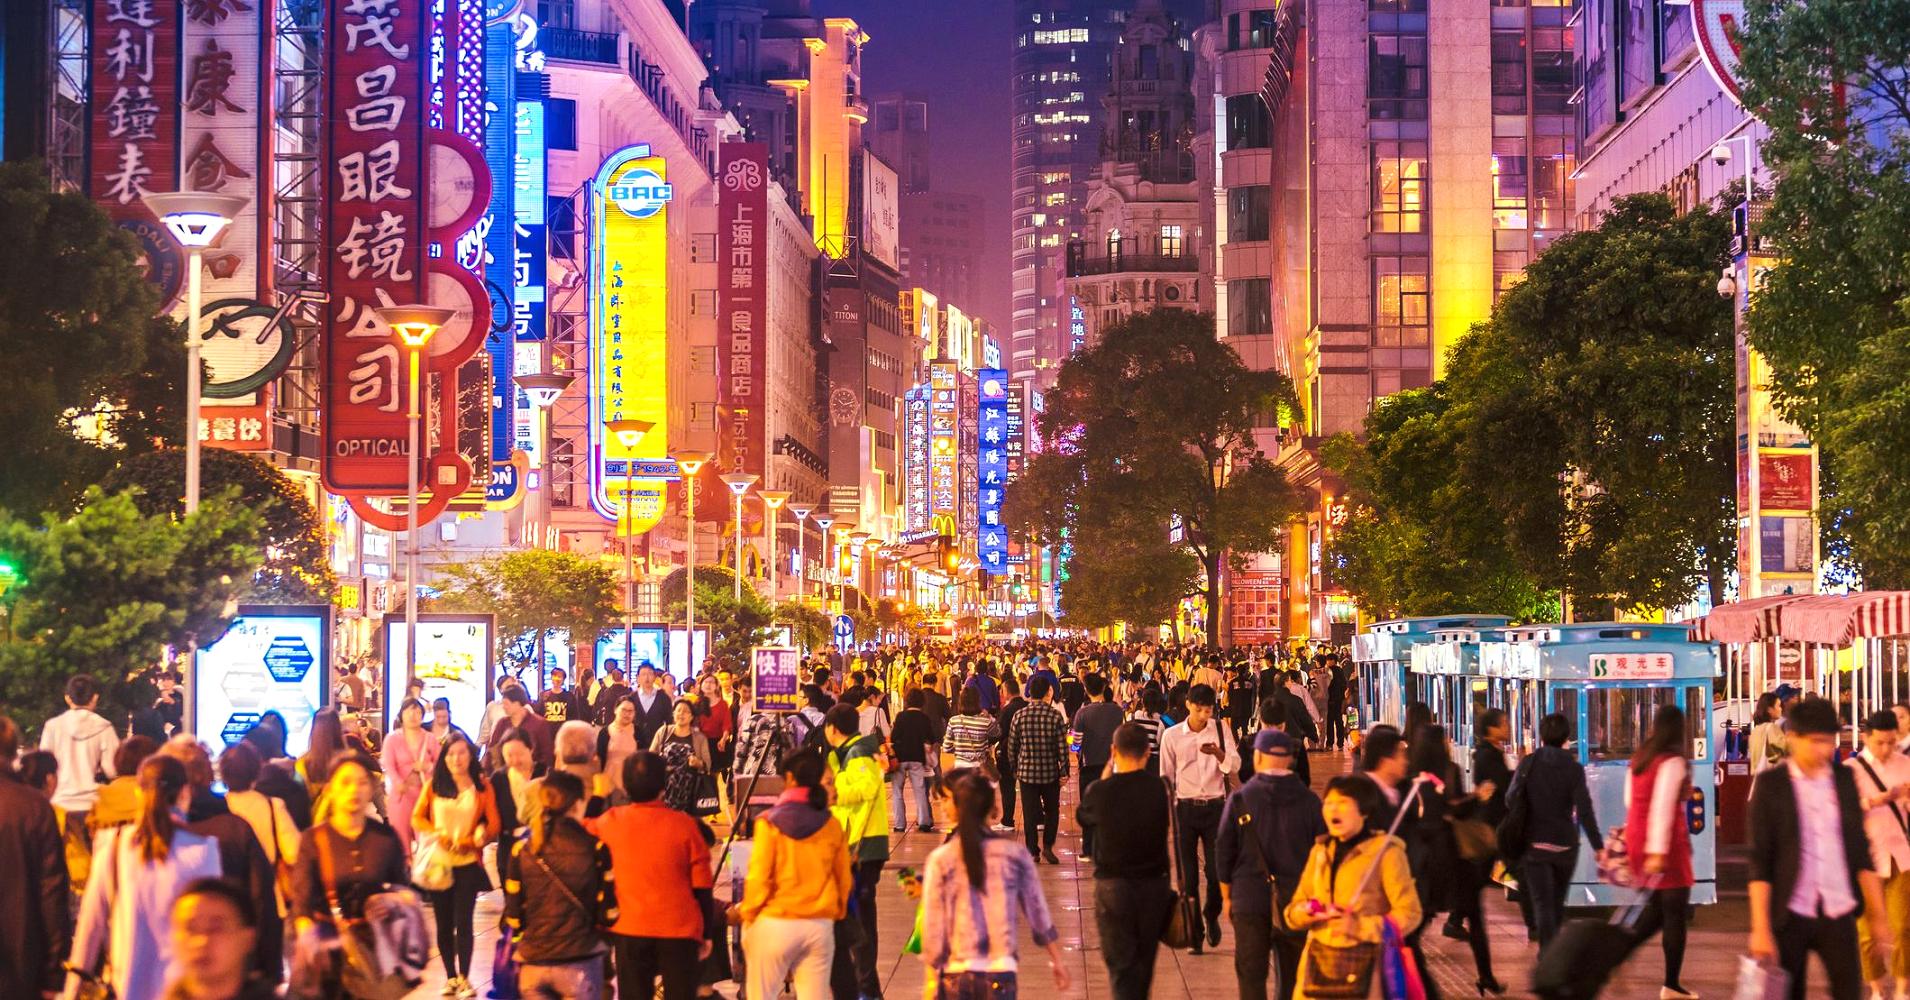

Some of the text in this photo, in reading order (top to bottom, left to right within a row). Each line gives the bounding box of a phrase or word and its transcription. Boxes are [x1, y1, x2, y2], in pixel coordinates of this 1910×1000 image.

[611, 186, 671, 200] BAC
[335, 0, 412, 412] 茂昌眼镜公司
[731, 203, 753, 396] 上海市第一食品商店
[834, 311, 858, 320] TITONI
[756, 651, 797, 676] 快照
[1616, 657, 1667, 669] 观光车
[1697, 741, 1704, 757] 2
